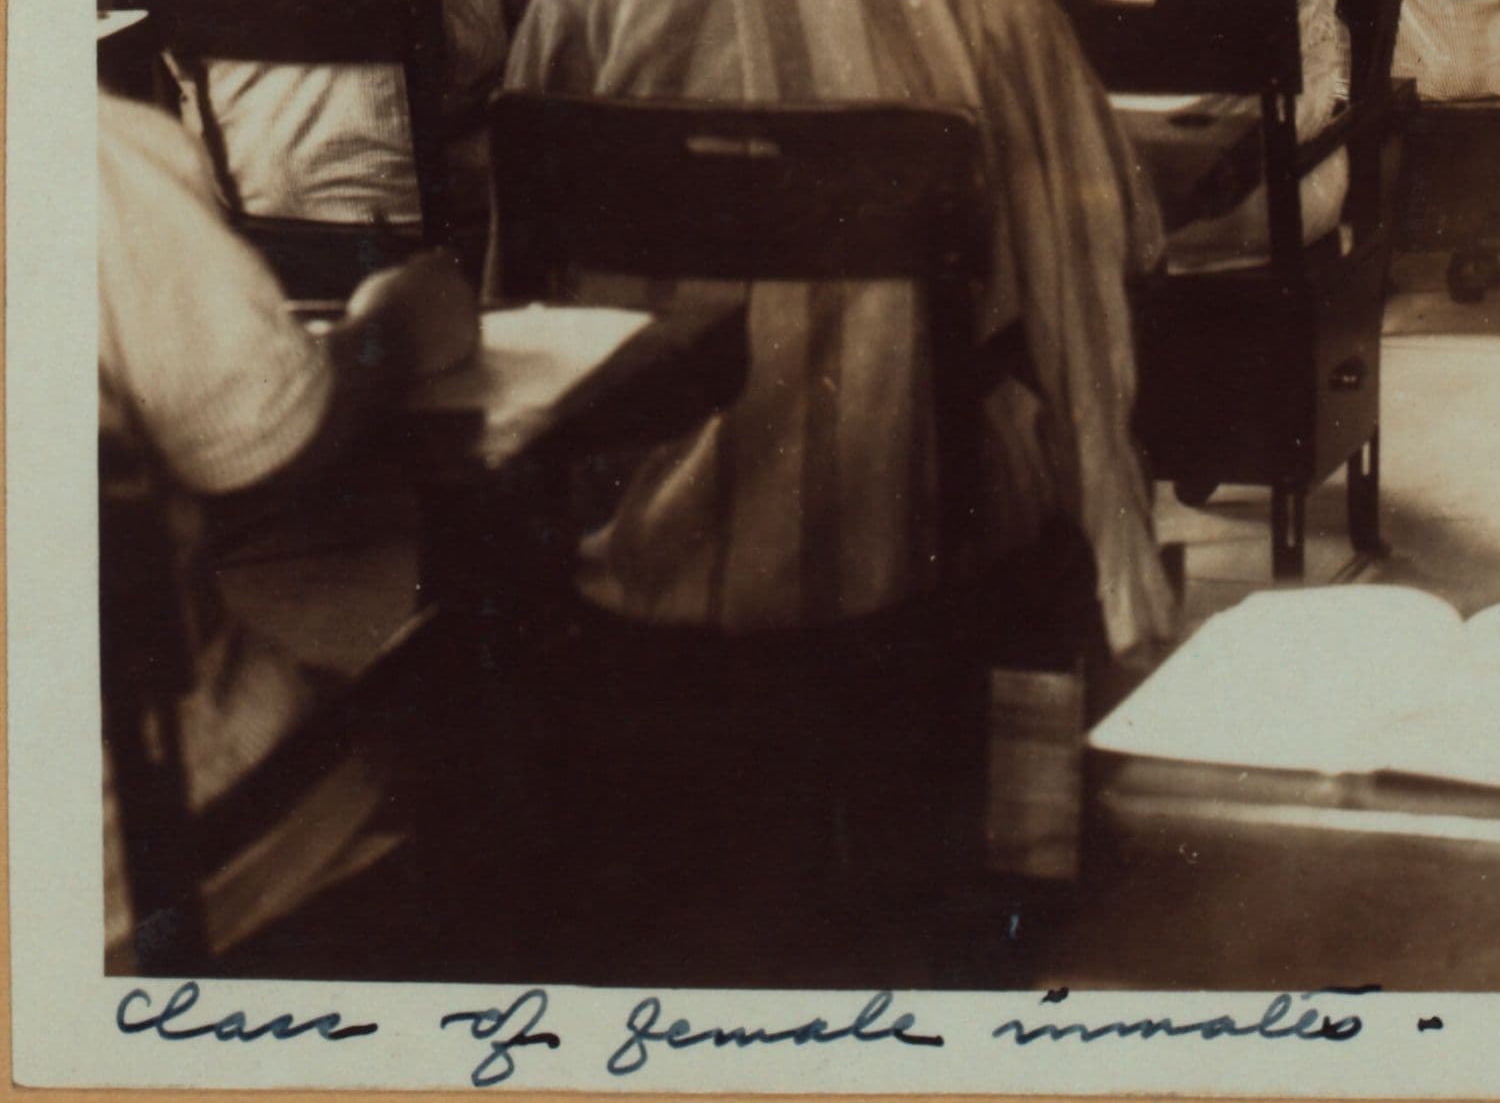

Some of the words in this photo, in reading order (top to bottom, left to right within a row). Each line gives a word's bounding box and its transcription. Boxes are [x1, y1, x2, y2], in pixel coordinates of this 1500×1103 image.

[117, 982, 377, 1040] Class
[442, 989, 560, 1087] of
[607, 990, 944, 1075] female
[992, 985, 1381, 1045] inmates
